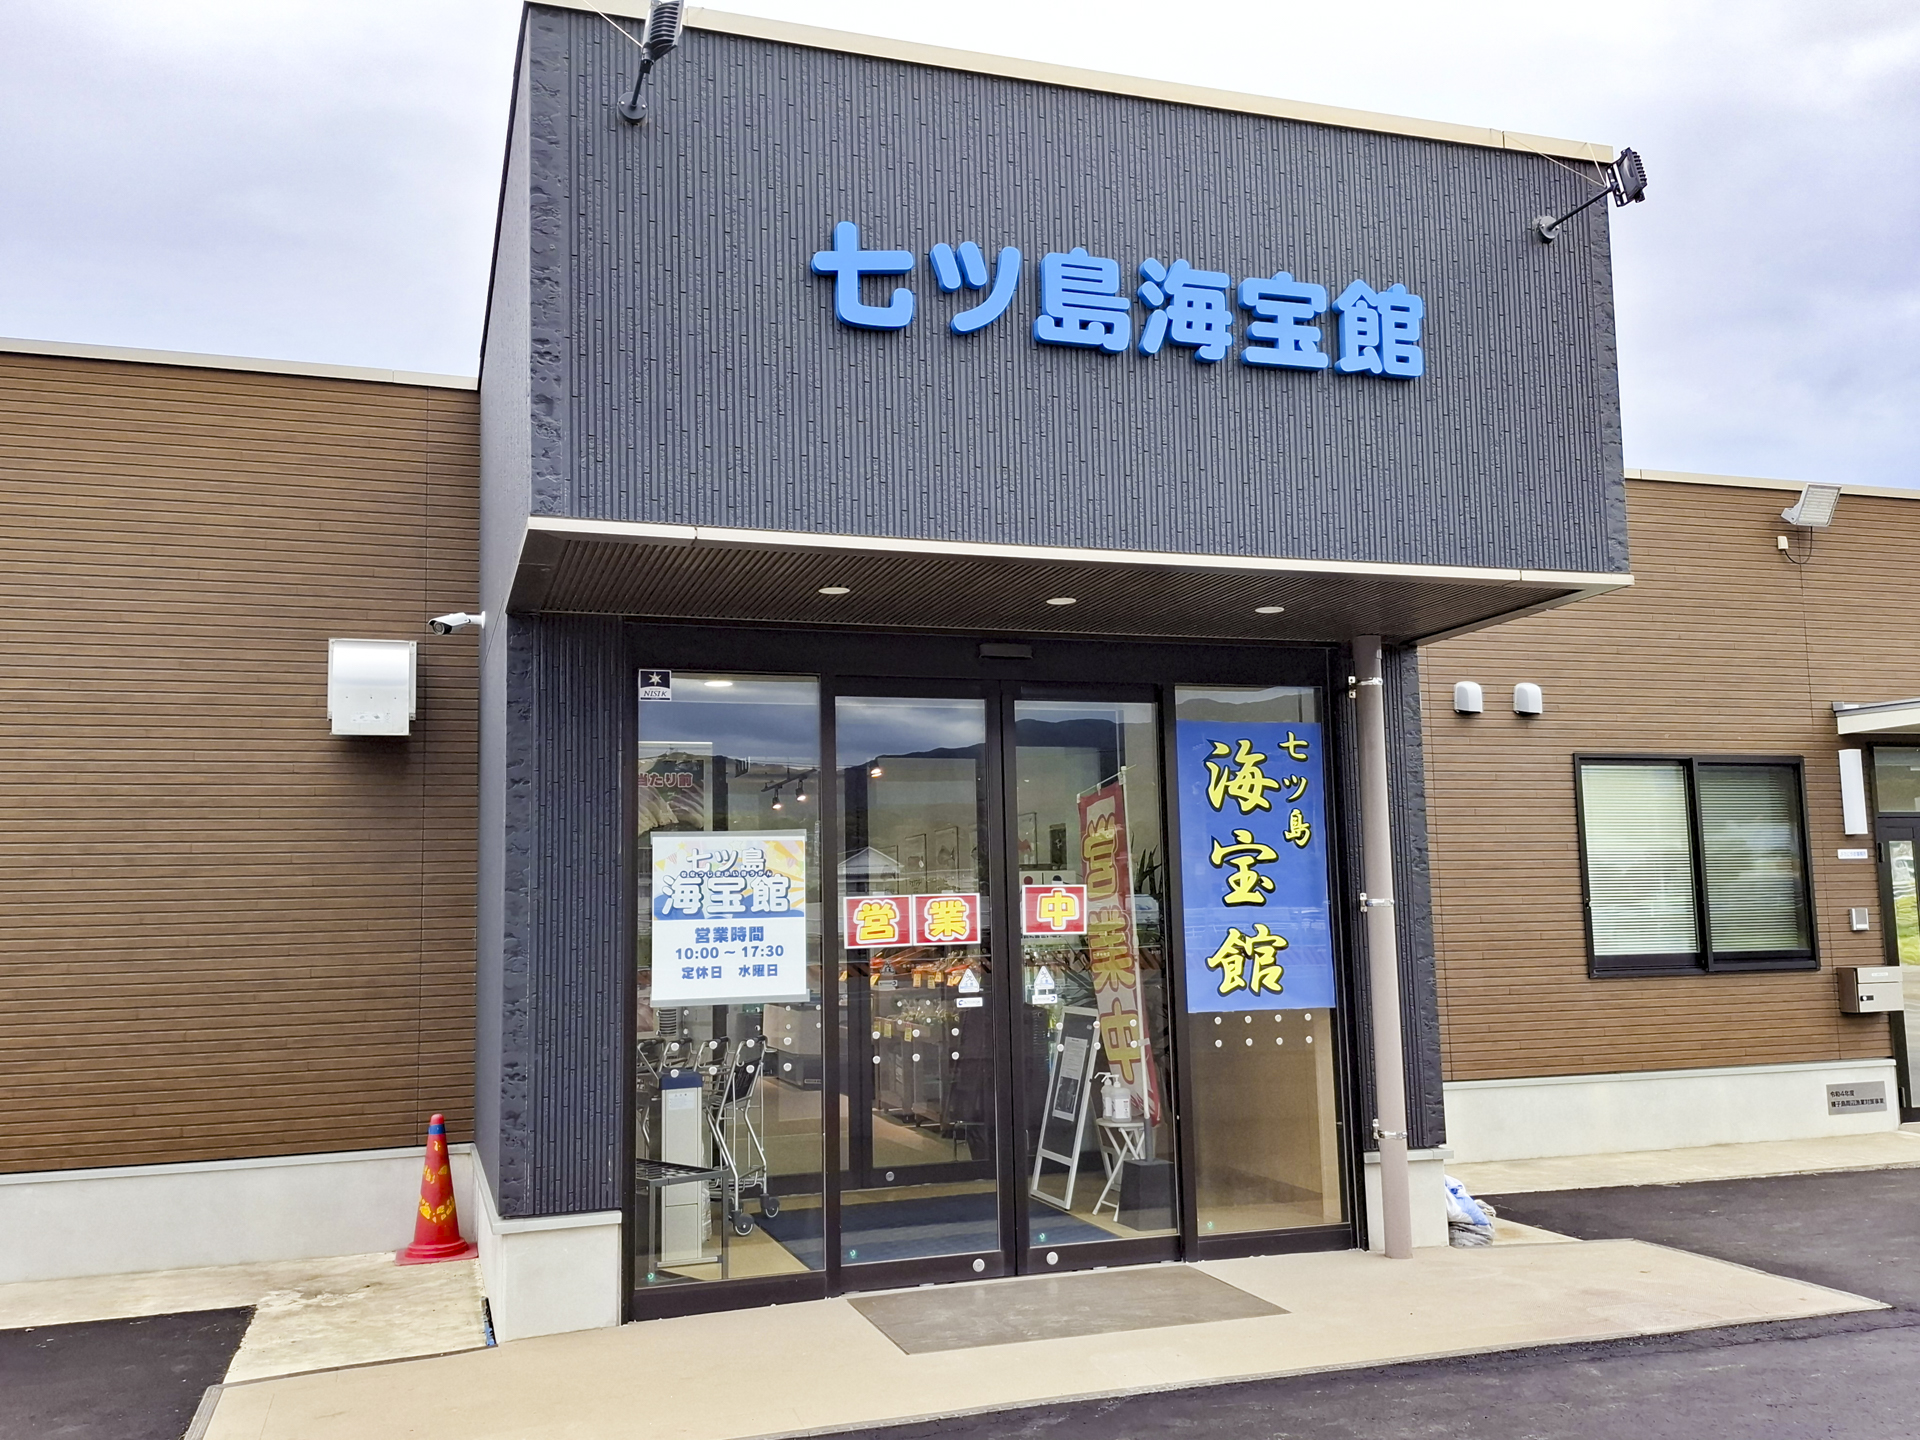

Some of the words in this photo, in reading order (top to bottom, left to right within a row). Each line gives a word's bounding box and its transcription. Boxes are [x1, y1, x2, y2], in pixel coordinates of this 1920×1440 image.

[811, 221, 1424, 379] 七ツ島海宝館
[1279, 731, 1312, 849] 七ツ島
[686, 847, 766, 873] 七ツ島
[1204, 738, 1289, 998] 海宝館
[661, 873, 791, 915] 海宝館
[694, 926, 764, 944] 営業時間
[681, 966, 722, 980] 定休日
[738, 964, 778, 978] 水曜日
